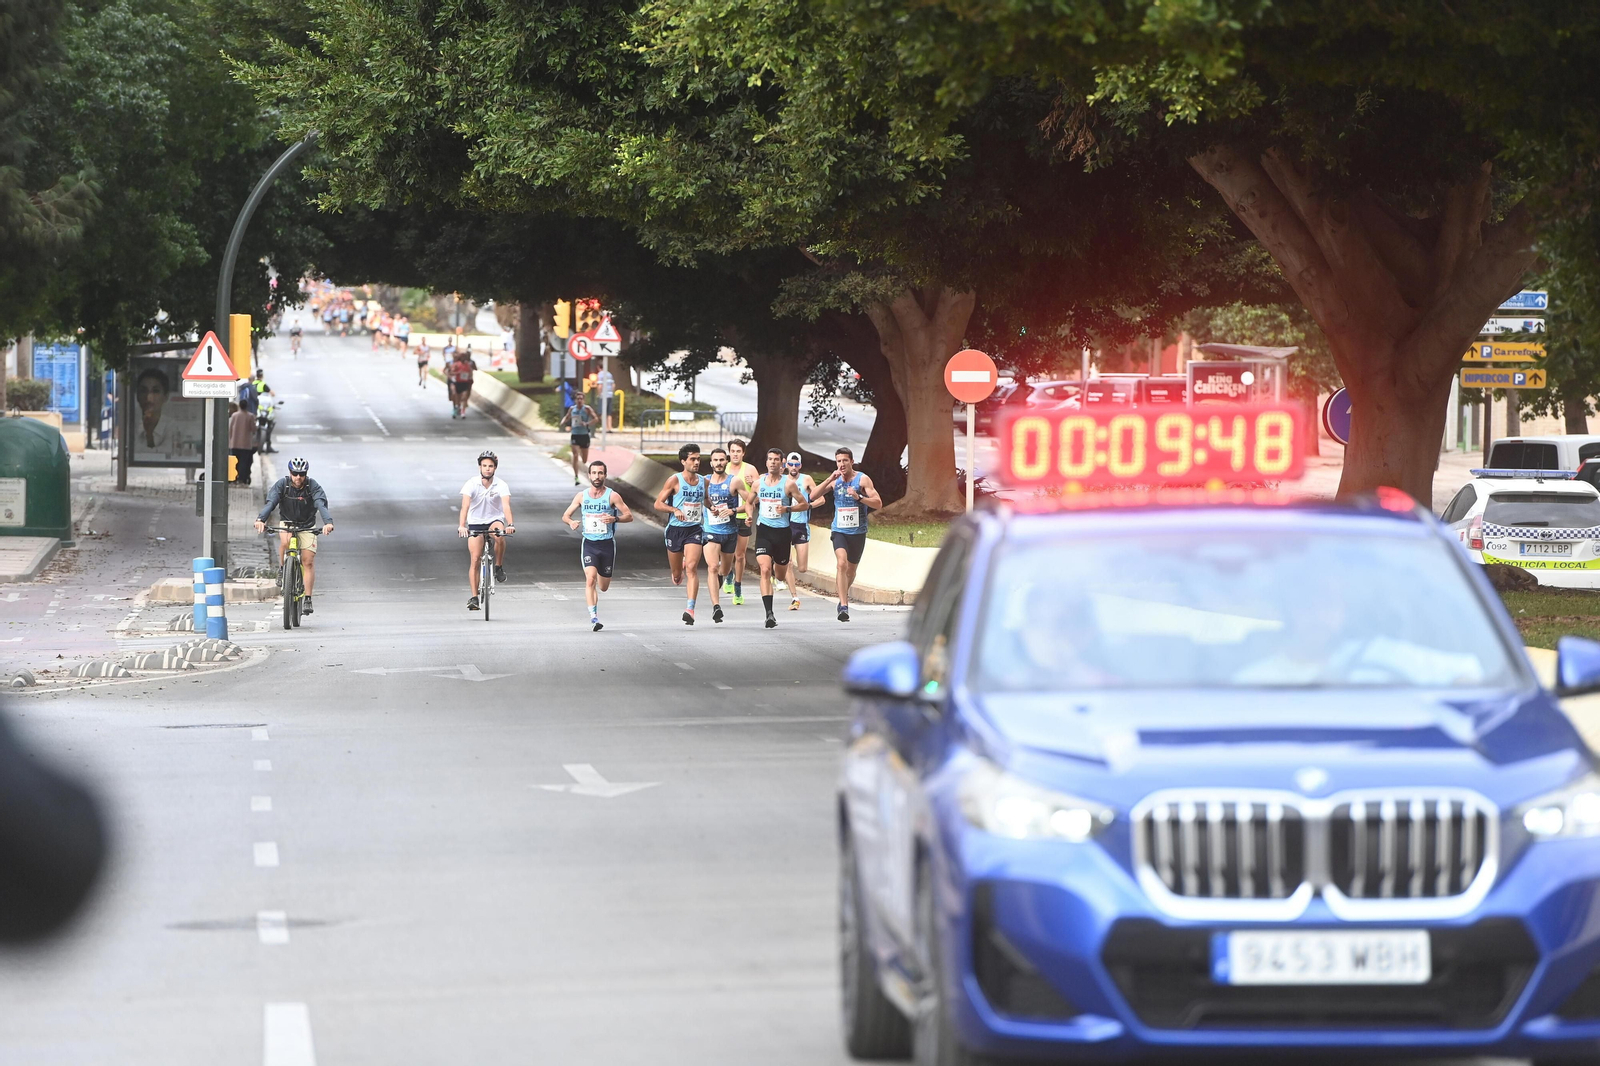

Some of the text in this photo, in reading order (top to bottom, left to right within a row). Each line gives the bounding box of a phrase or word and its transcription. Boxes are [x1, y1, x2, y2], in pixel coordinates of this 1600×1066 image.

[1208, 375, 1233, 383] KING
[1465, 374, 1510, 383] HIPERCOR
[1194, 381, 1246, 397] CHICKEN
[682, 490, 703, 498] nerja
[760, 491, 781, 499] nerja
[584, 503, 607, 511] nerja
[1526, 545, 1569, 553] 7112 LBP
